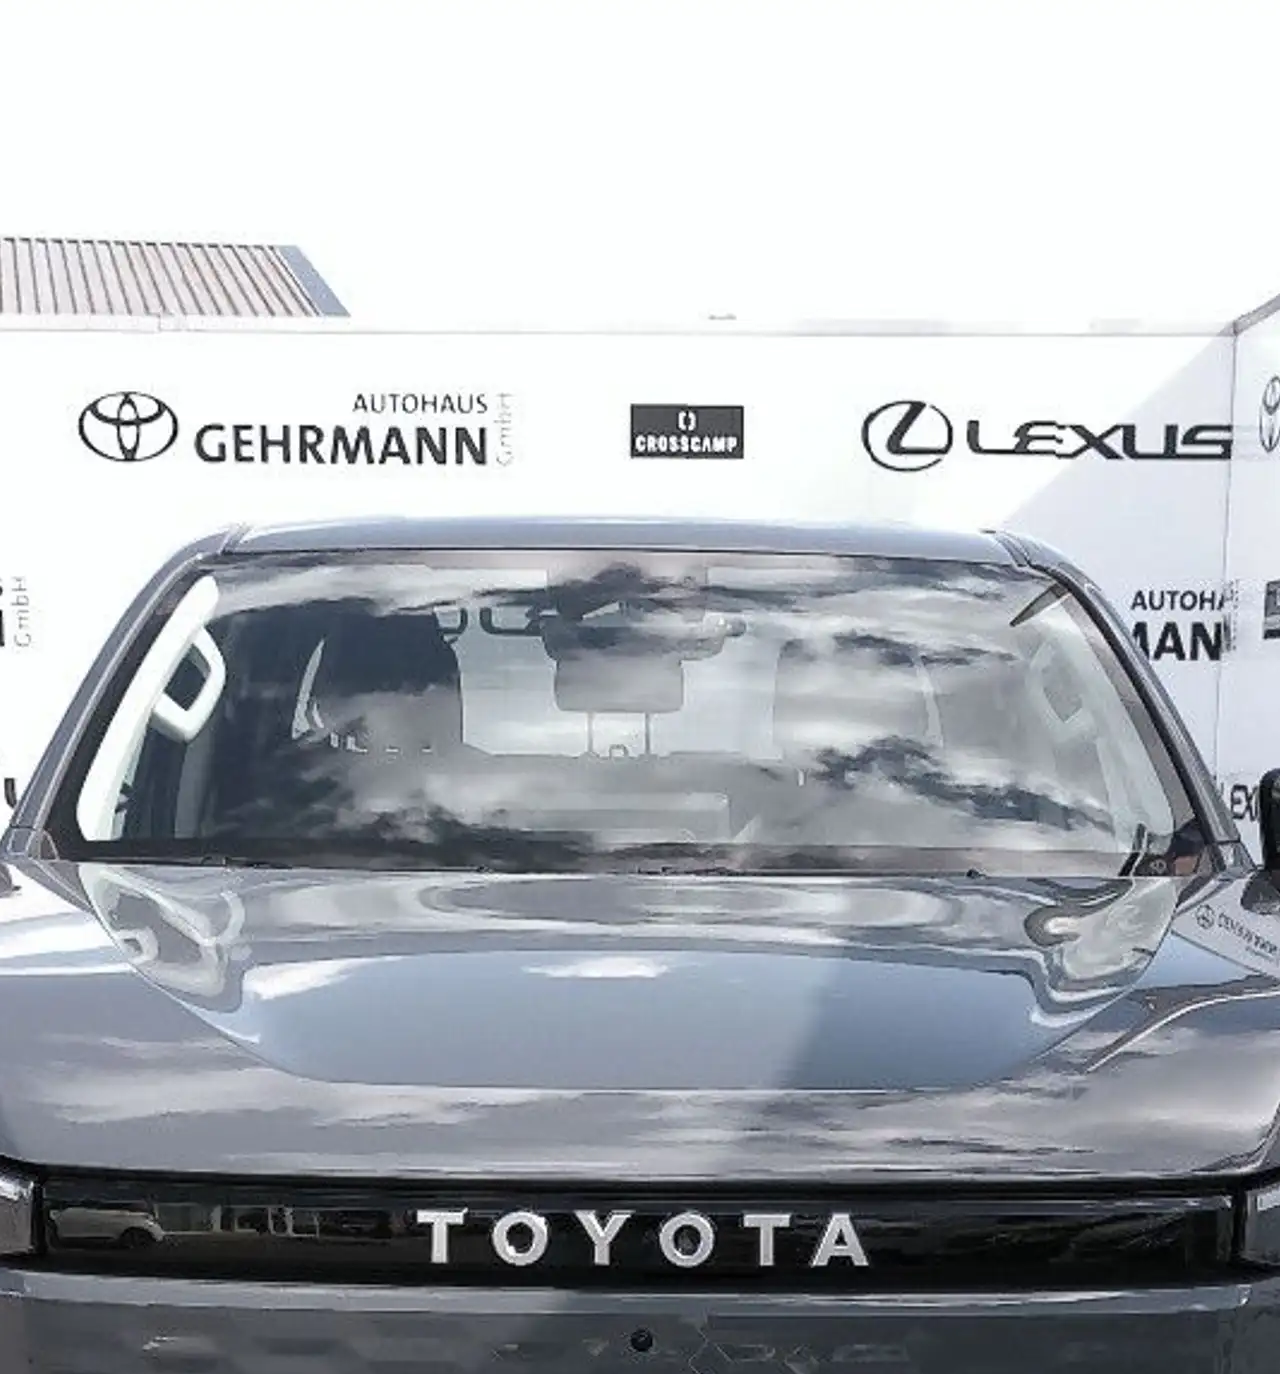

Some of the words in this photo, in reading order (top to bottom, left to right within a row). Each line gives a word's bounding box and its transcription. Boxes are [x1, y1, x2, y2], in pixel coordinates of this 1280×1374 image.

[353, 394, 487, 413] AUTOHAUS
[194, 424, 486, 465] GEHRMANN
[636, 435, 736, 452] CROSSCAMP
[967, 420, 1232, 460] LEXUS
[11, 577, 31, 647] GmbH
[417, 1208, 868, 1266] TOYOTA
